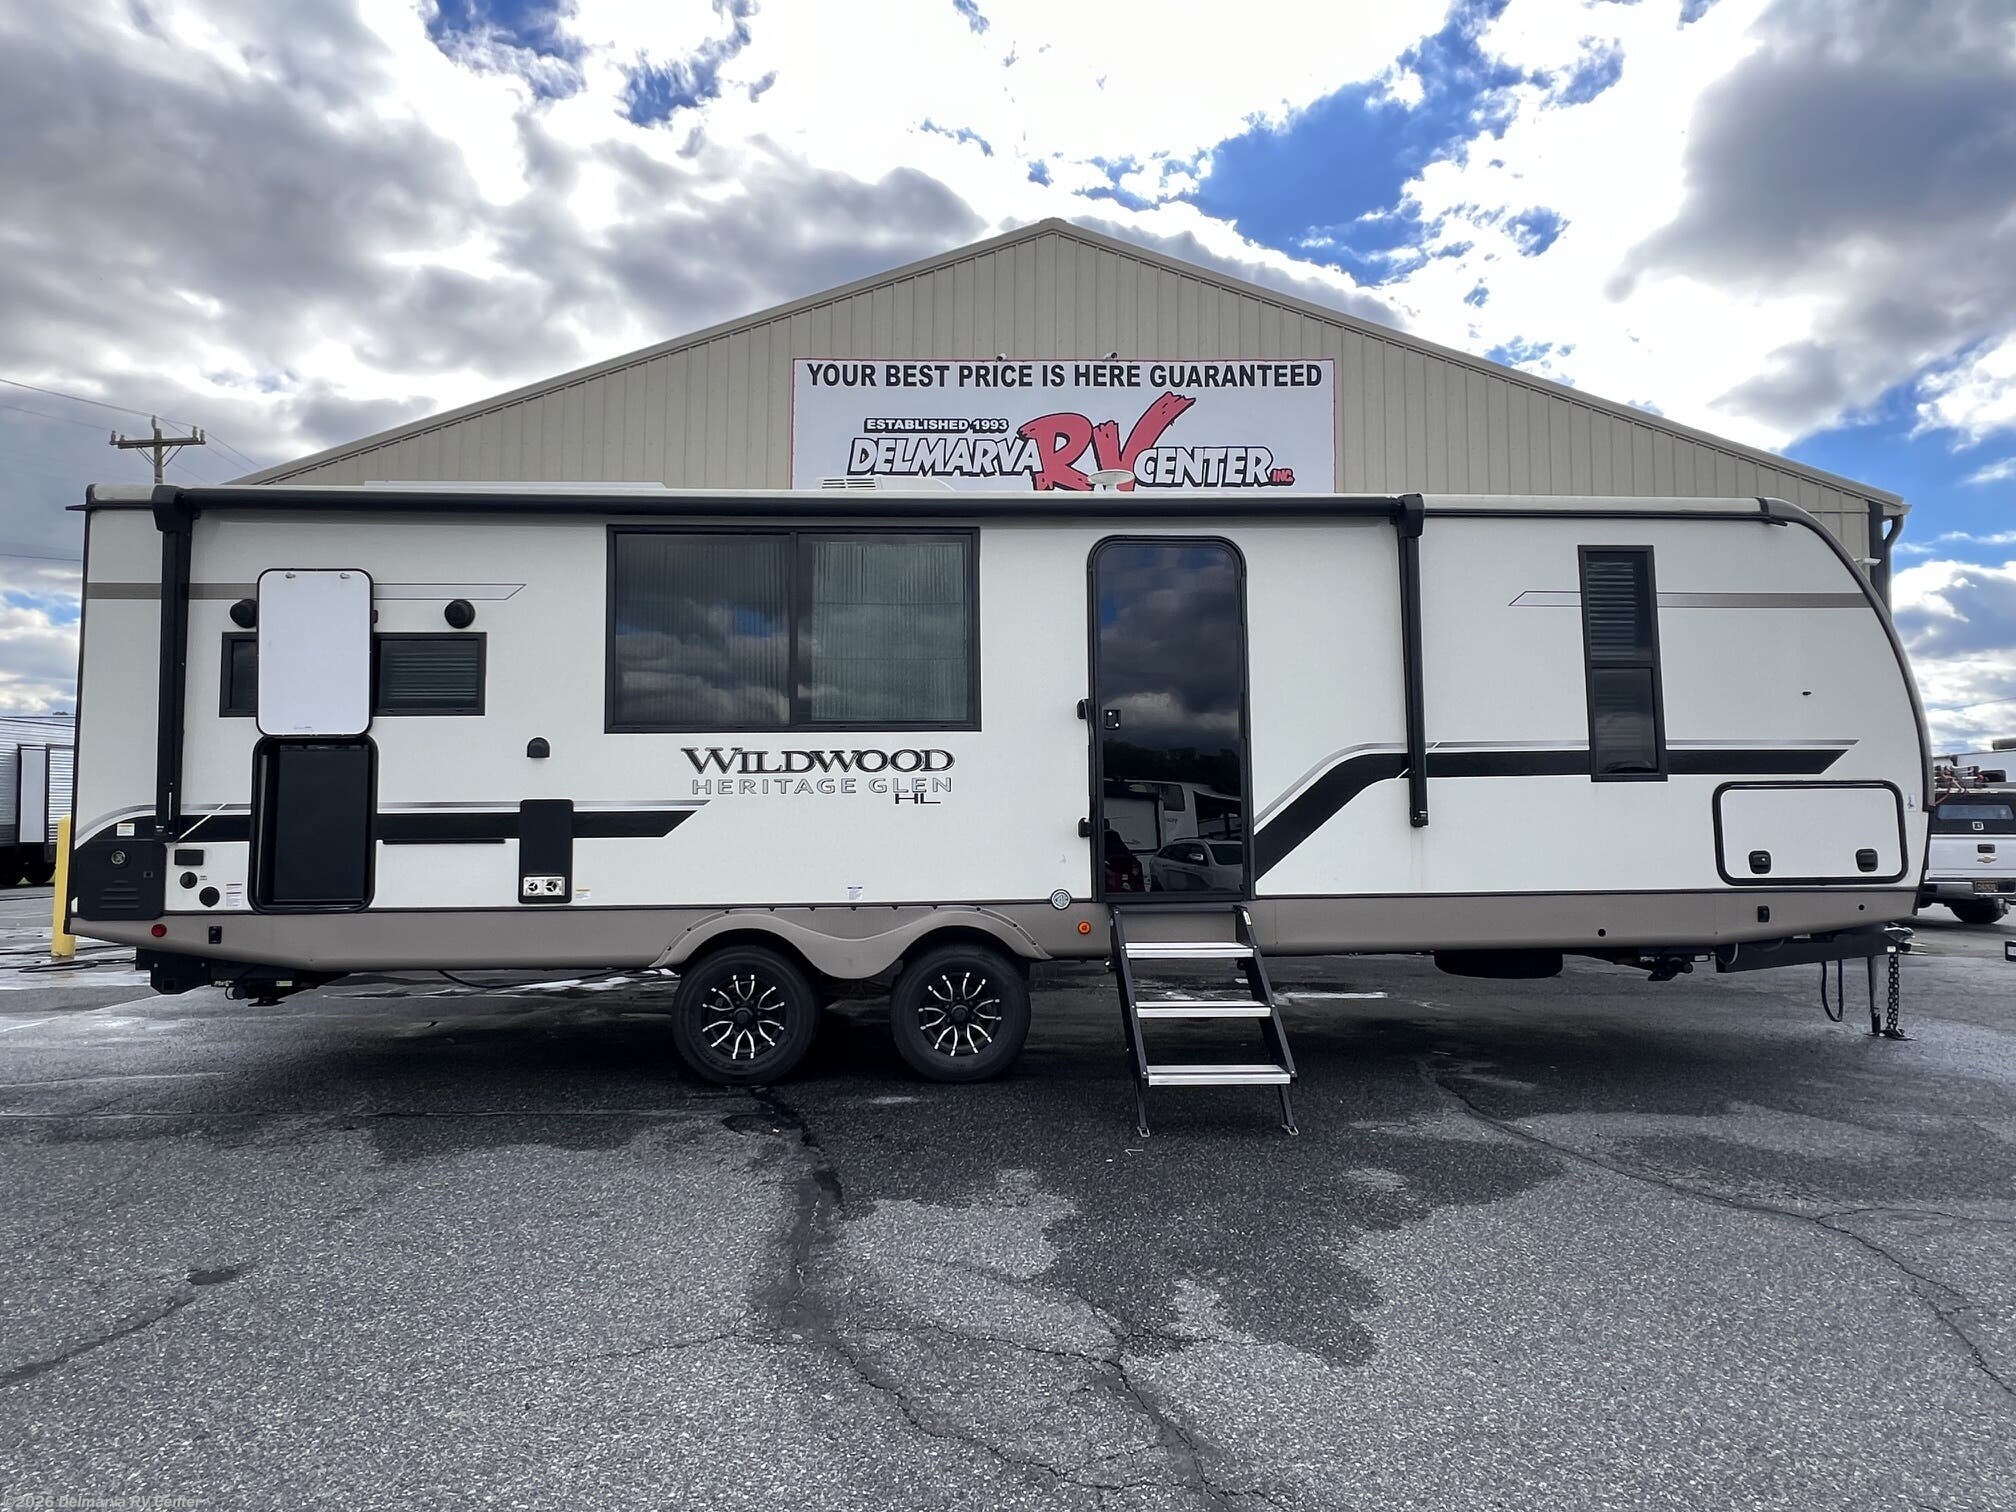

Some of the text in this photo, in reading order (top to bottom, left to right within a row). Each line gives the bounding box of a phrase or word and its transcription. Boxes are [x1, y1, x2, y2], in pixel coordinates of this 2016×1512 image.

[807, 363, 1322, 388] YOUR BEST PRICE IS HERE GUARANTEED
[864, 418, 1009, 433] ESTABLISHED 1993
[847, 437, 1043, 477] DELMARVA
[1017, 391, 1196, 491] RV
[1133, 446, 1273, 487] CENTER
[691, 776, 952, 795] HERITAGE GLEN
[894, 793, 941, 805] HL
